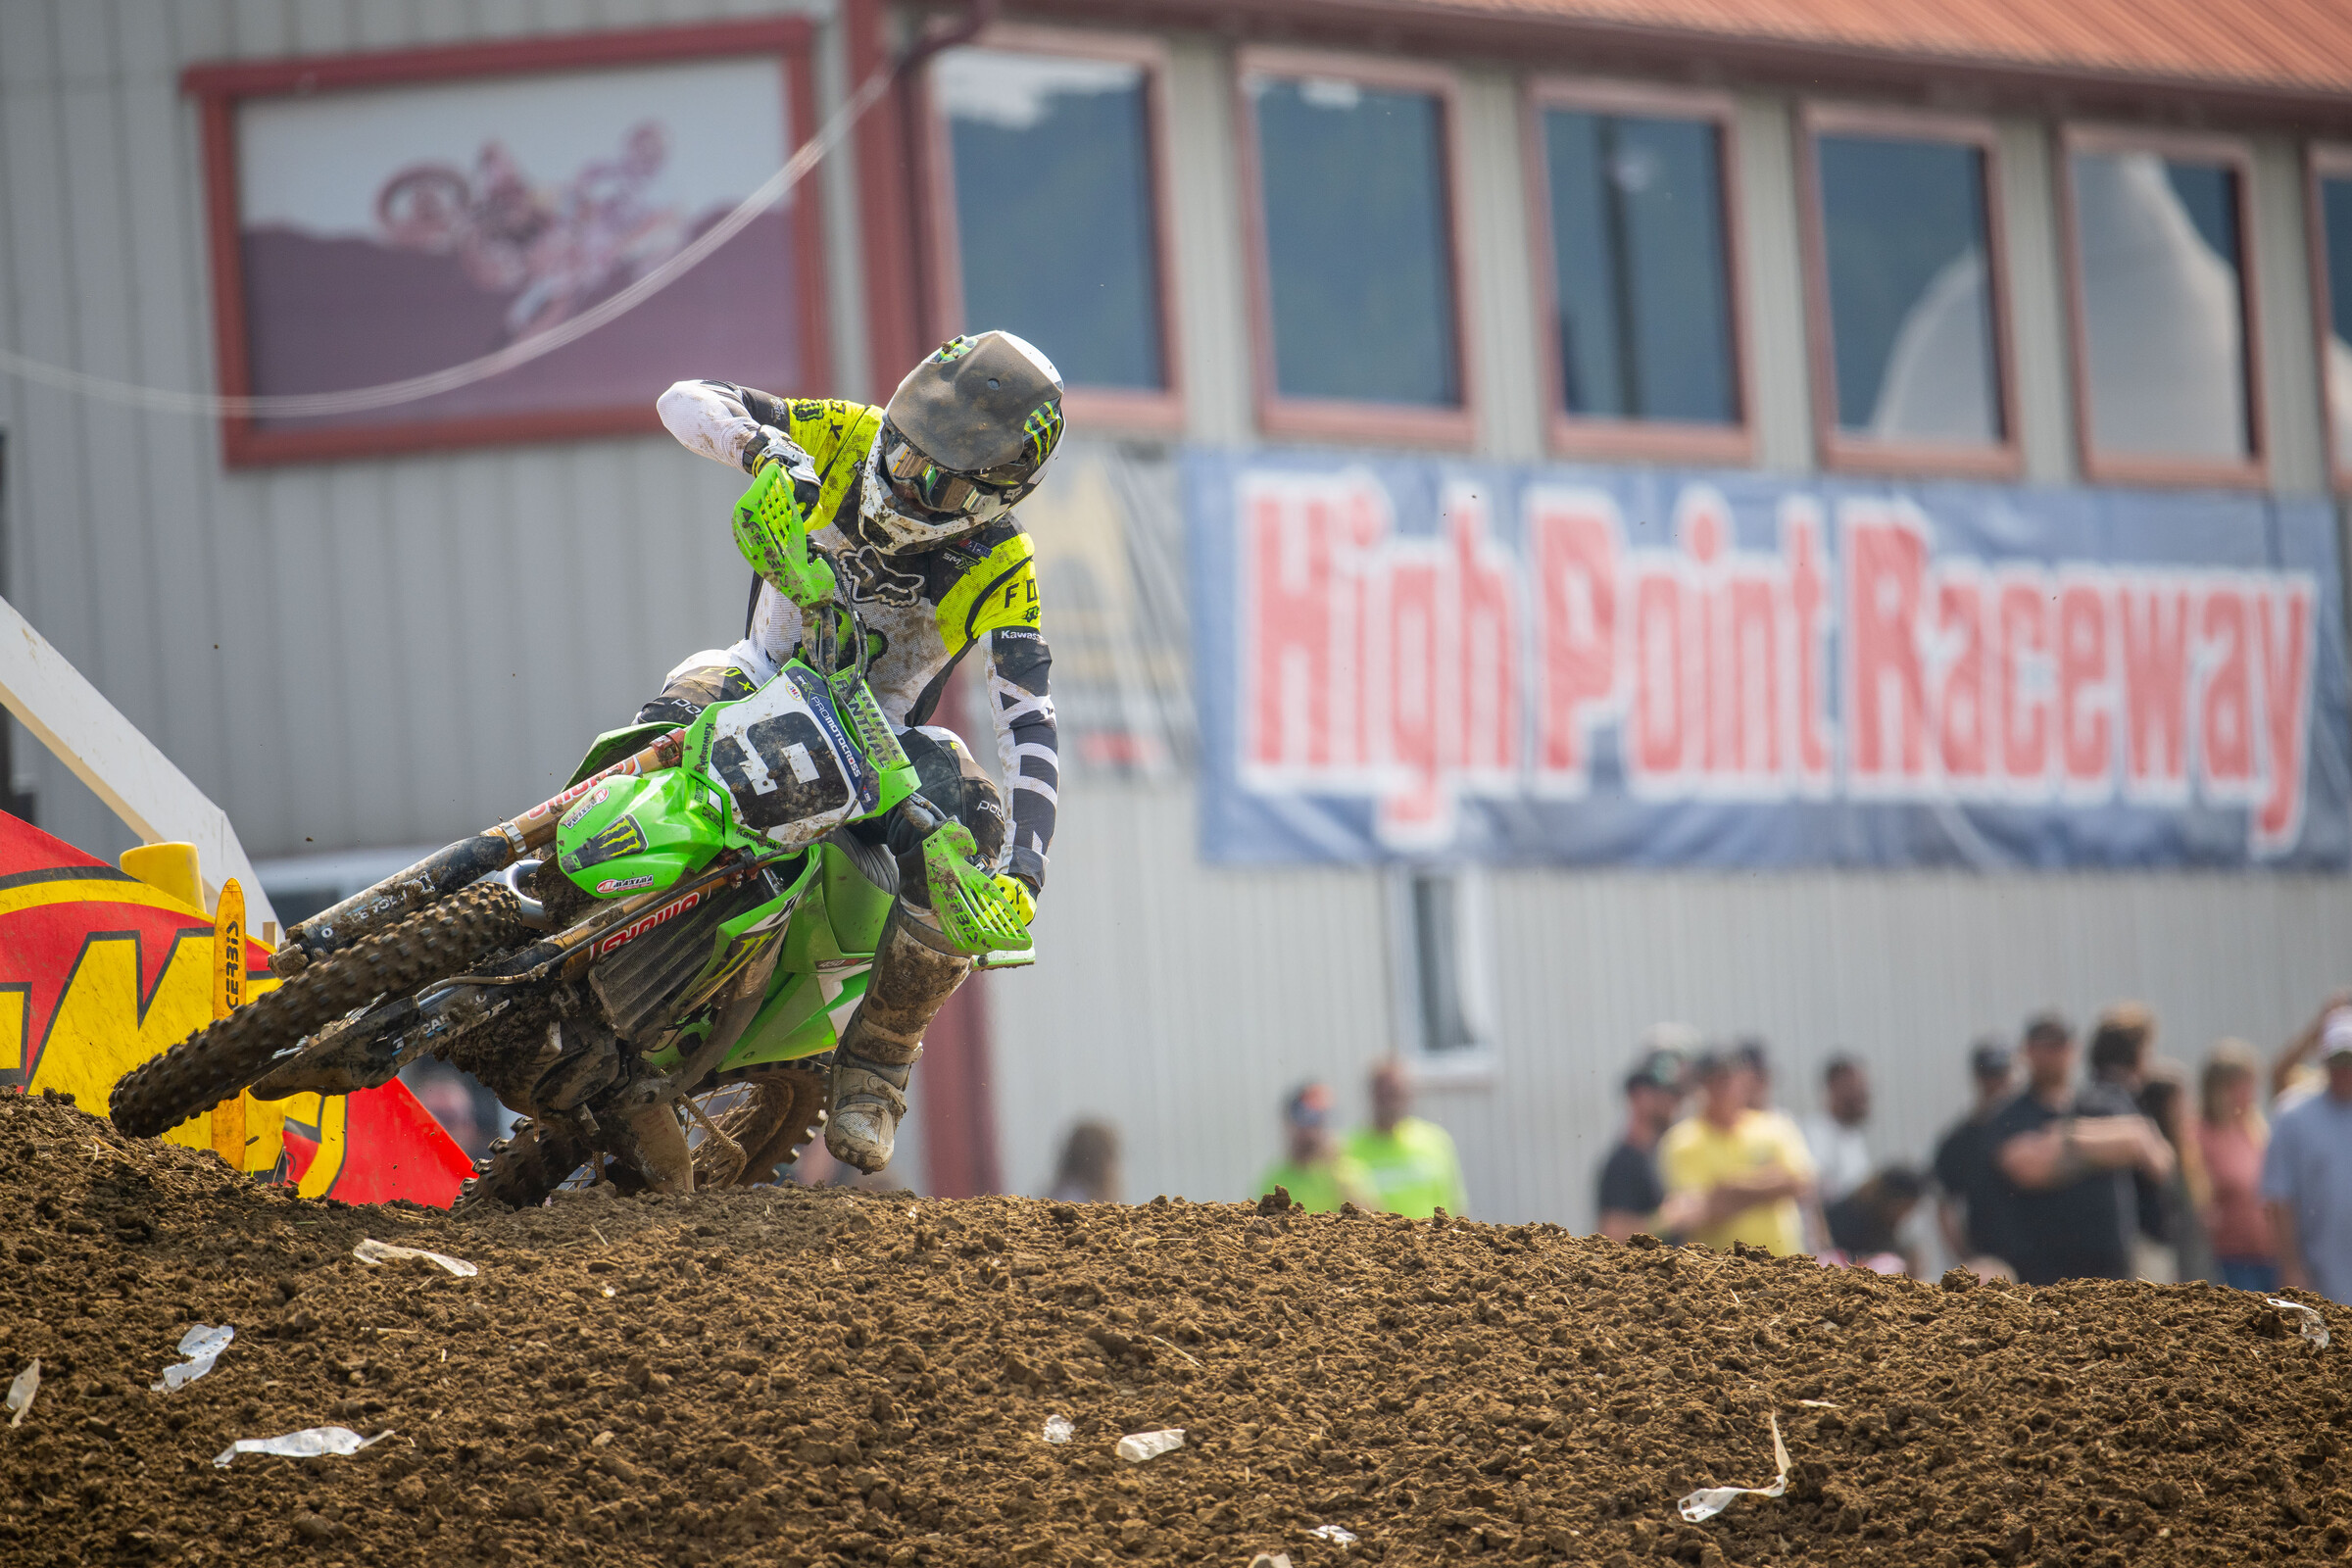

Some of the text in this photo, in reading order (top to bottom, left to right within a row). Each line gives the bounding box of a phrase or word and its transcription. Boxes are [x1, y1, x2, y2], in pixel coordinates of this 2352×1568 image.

[1004, 578, 1038, 609] FO
[699, 666, 756, 692] FOX
[1243, 478, 2313, 845] High Point Raceway
[834, 678, 886, 769] RNTHAL
[848, 669, 903, 761] ENTHAL
[710, 711, 850, 830] 9
[613, 875, 653, 888] MAXIMA
[735, 826, 781, 851] Kawaki
[225, 919, 240, 1011] CERBIS
